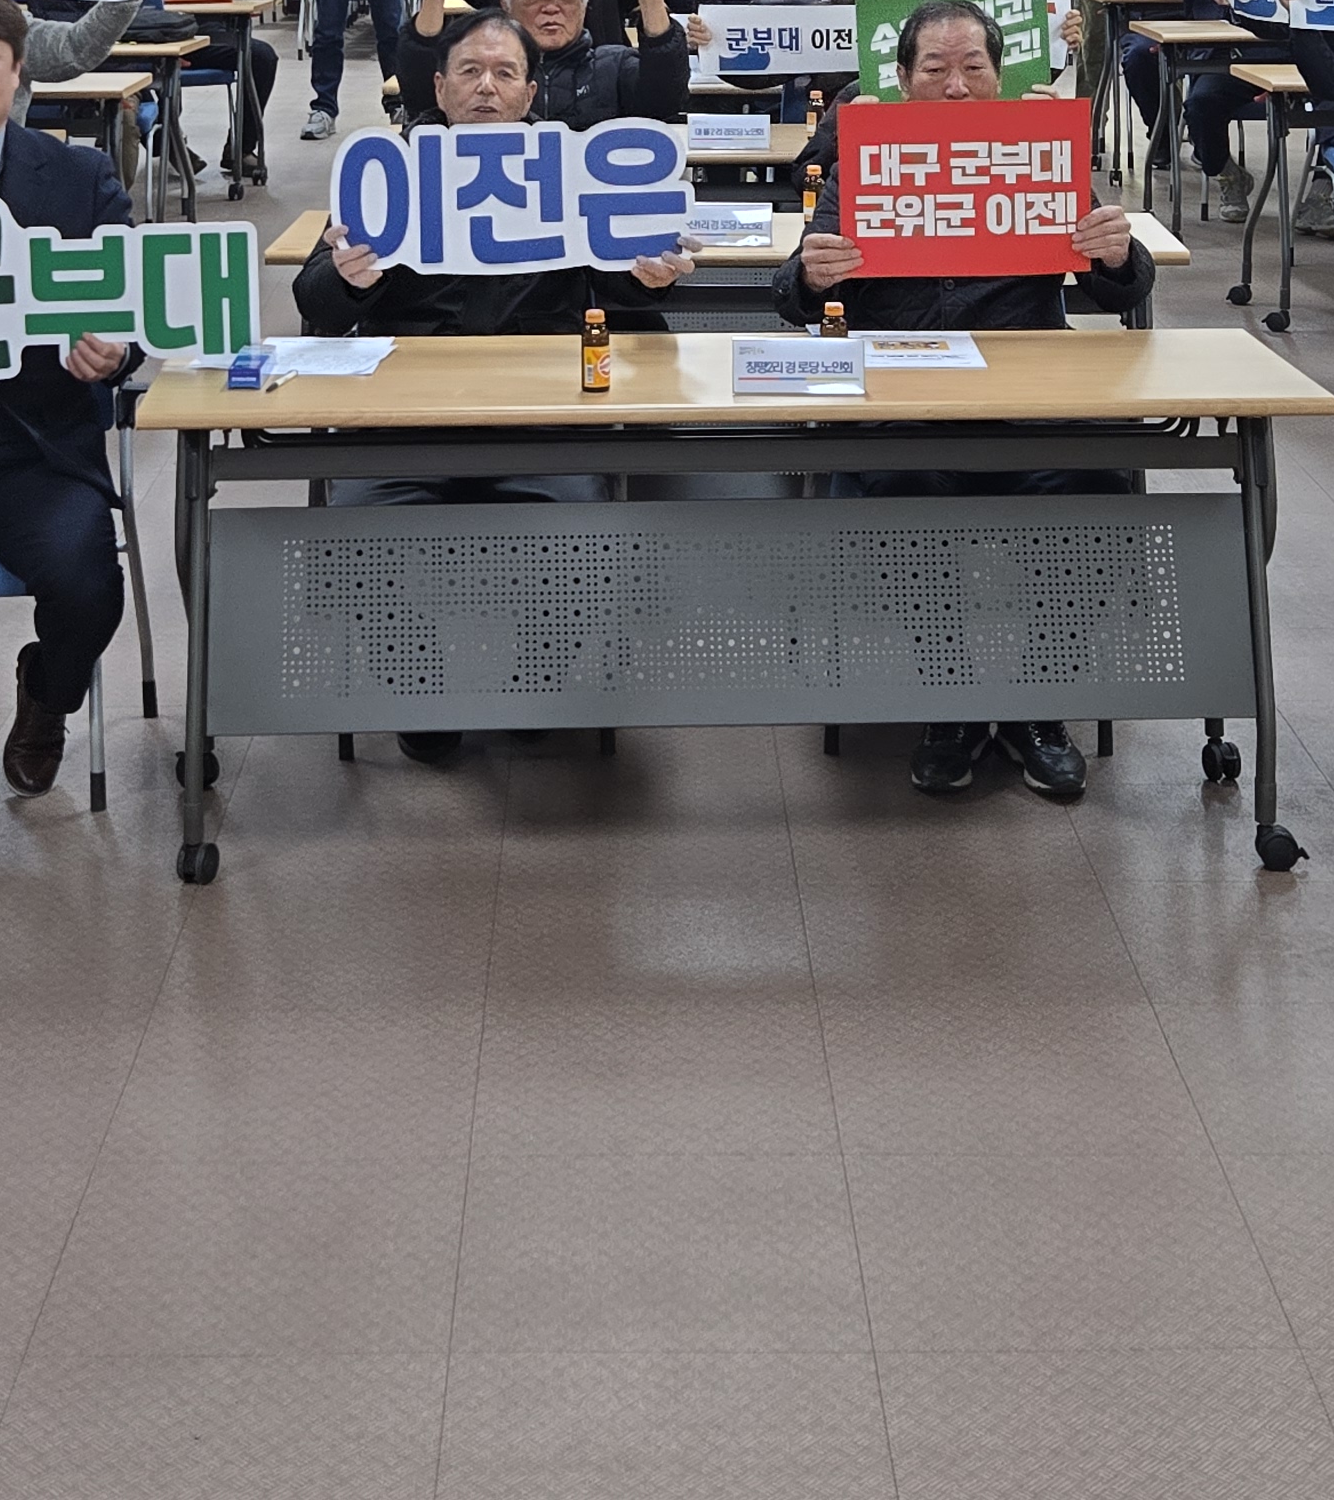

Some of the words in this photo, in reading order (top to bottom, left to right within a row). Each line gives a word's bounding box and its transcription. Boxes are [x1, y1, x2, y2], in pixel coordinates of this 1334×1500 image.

[725, 27, 800, 52] 군부대
[811, 28, 853, 51] 이전
[860, 143, 940, 186] 대구
[950, 141, 1072, 185] 군부대
[338, 128, 687, 265] 이전은
[854, 193, 975, 238] 군위군
[986, 191, 1077, 235] 이전!
